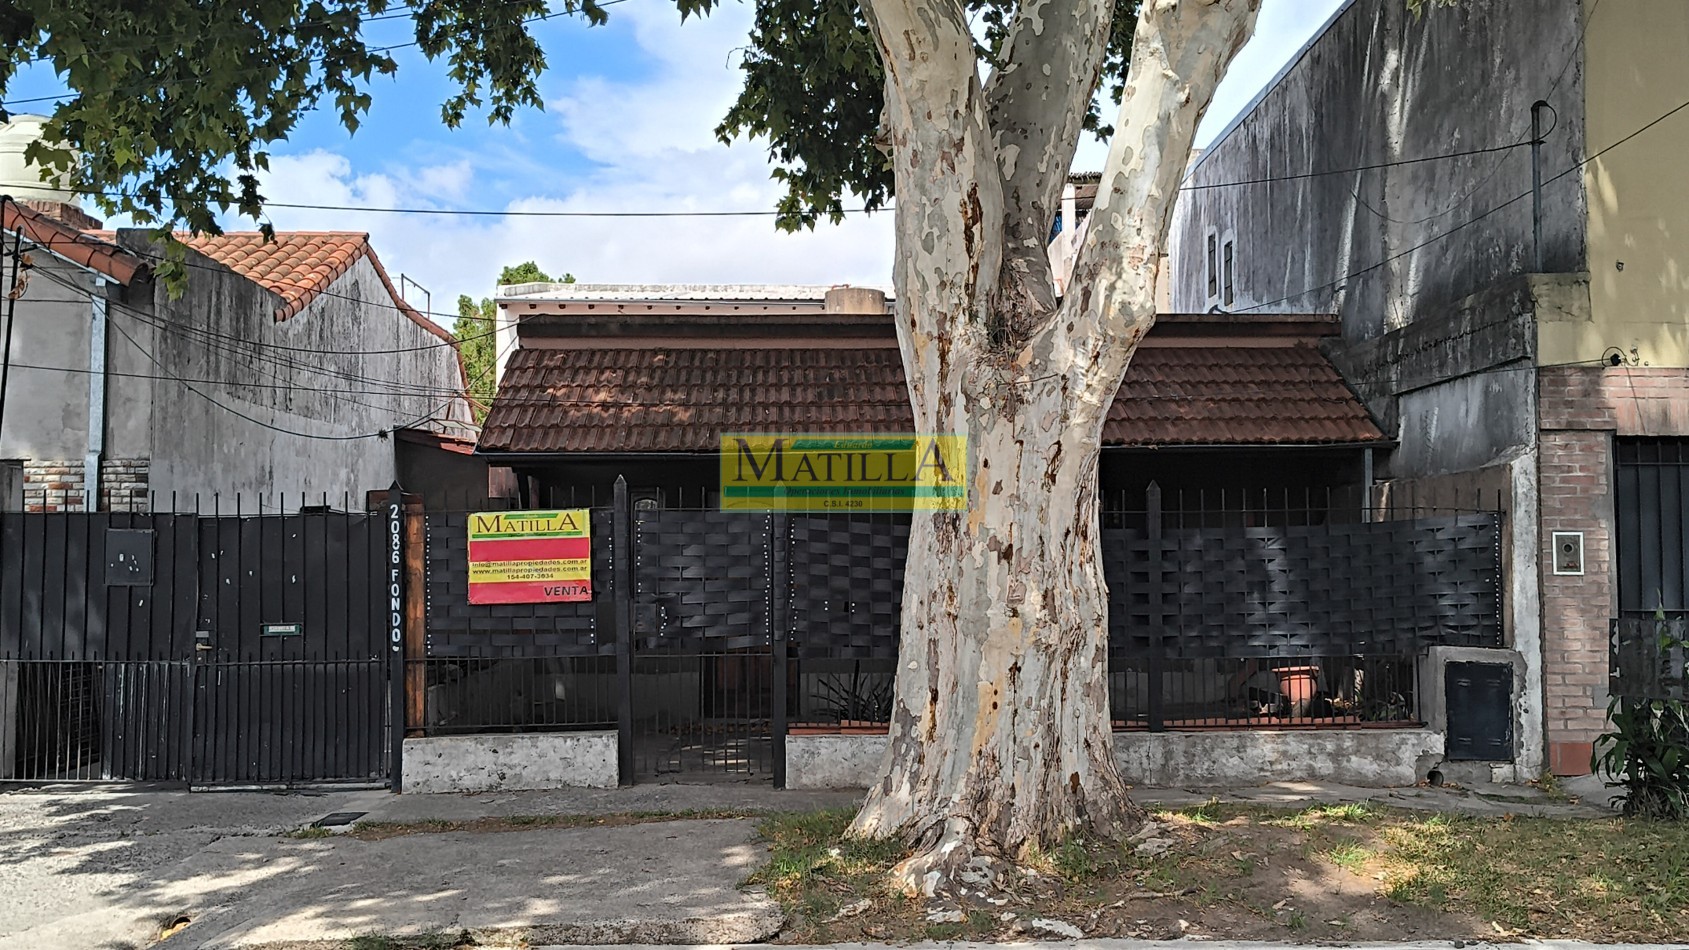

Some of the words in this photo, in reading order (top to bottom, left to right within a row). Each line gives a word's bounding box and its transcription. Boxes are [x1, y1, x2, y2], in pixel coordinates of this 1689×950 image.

[476, 513, 579, 533] MATILLA
[390, 504, 400, 564] 2086
[544, 586, 589, 596] VENTA
